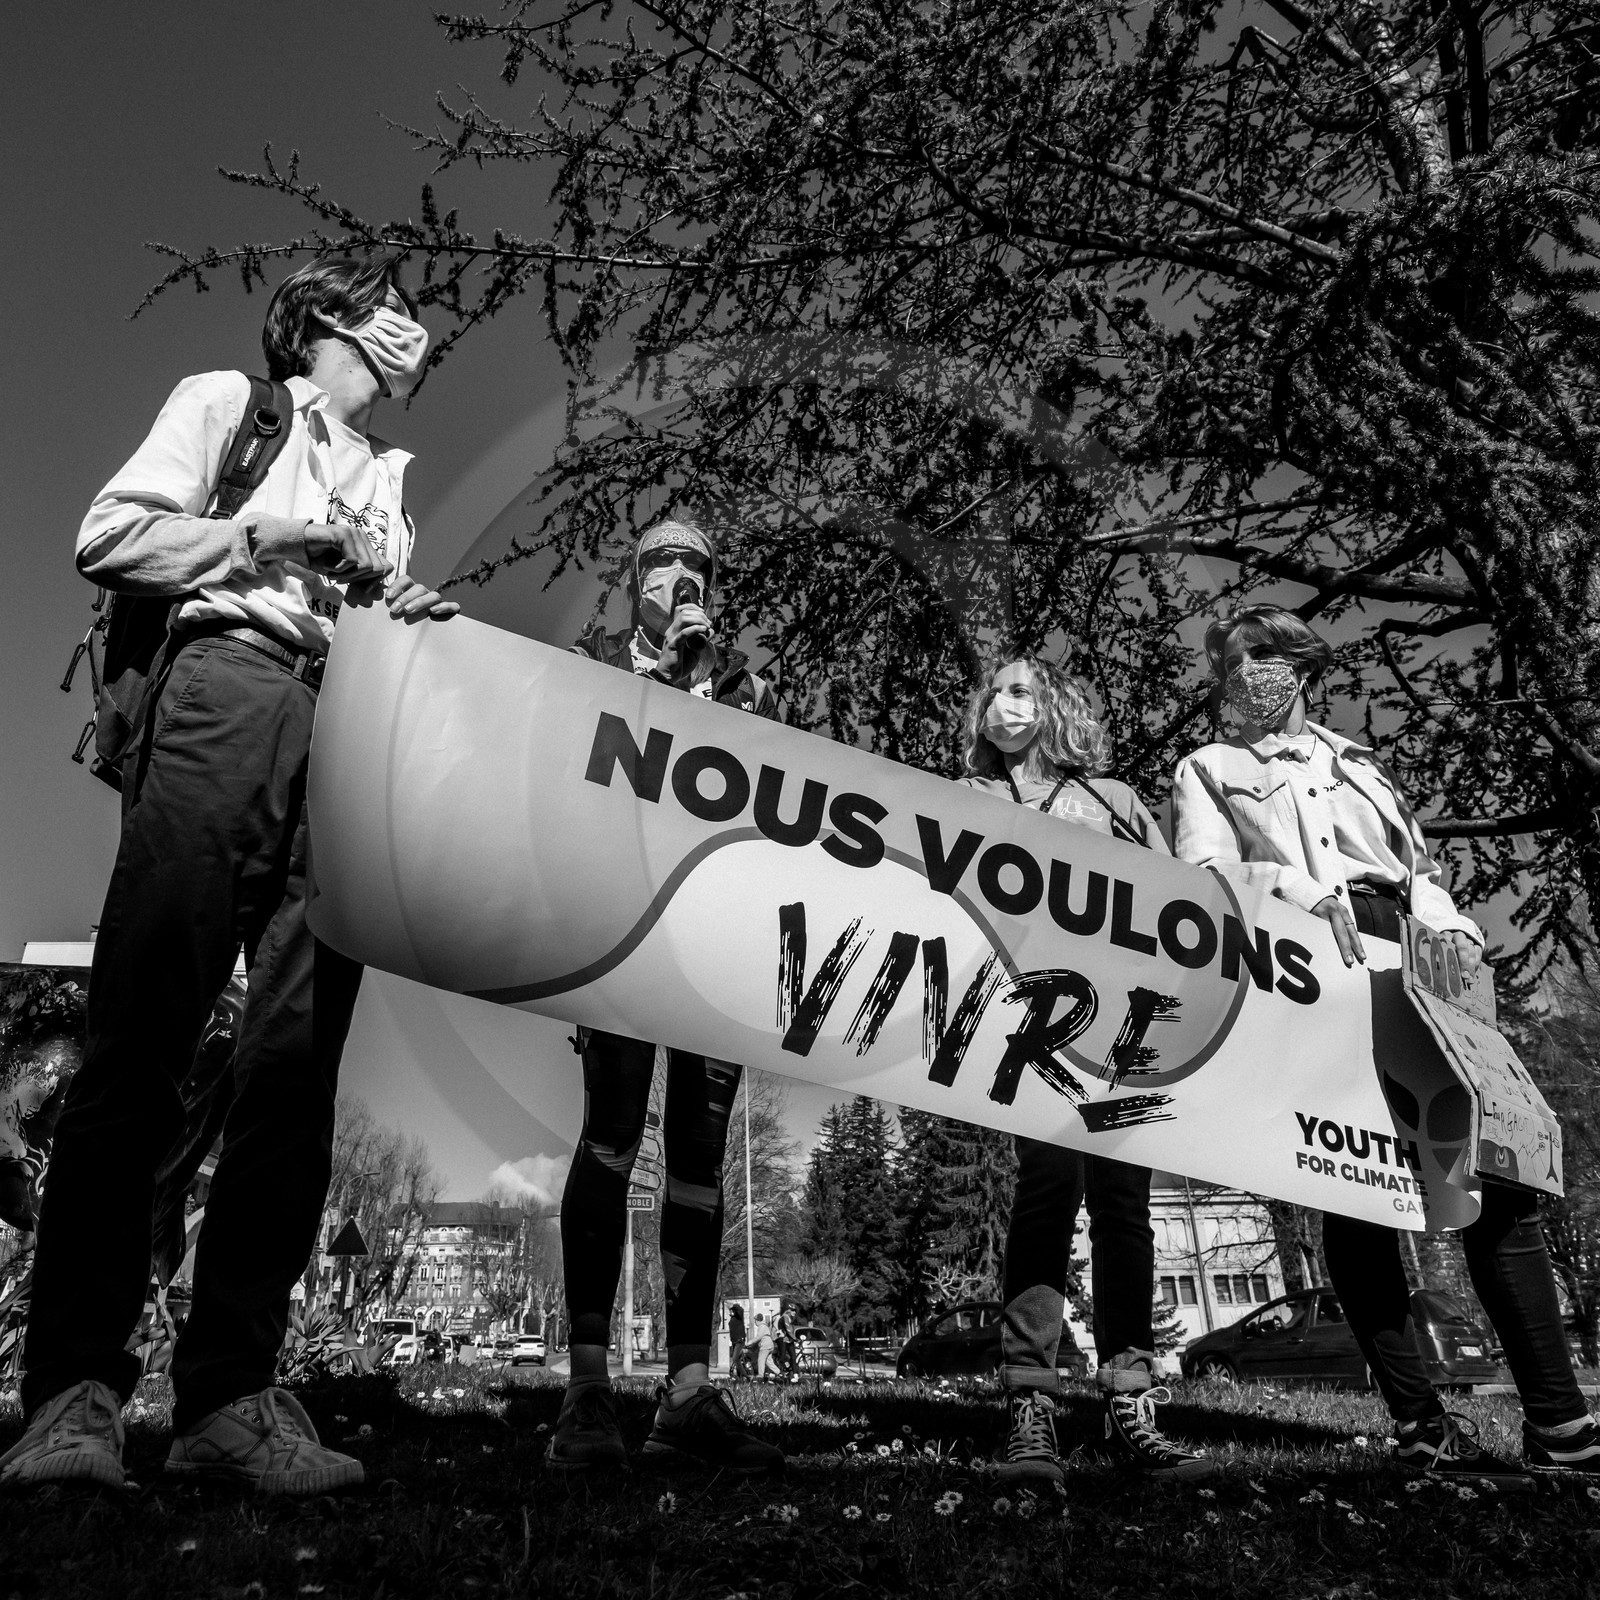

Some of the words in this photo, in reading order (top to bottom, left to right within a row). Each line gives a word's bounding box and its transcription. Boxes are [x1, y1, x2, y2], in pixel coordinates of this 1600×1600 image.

[241, 438, 259, 467] EASTPAK
[584, 711, 889, 869] NOUS
[915, 813, 1321, 1005] VOULONS
[776, 901, 1184, 1133] VIVRE
[1294, 1111, 1422, 1171] YOUTH
[1296, 1151, 1337, 1178] FOR
[1340, 1163, 1428, 1196] CLIMATE
[626, 1199, 650, 1207] NOBLE
[1392, 1198, 1430, 1215] GAP
